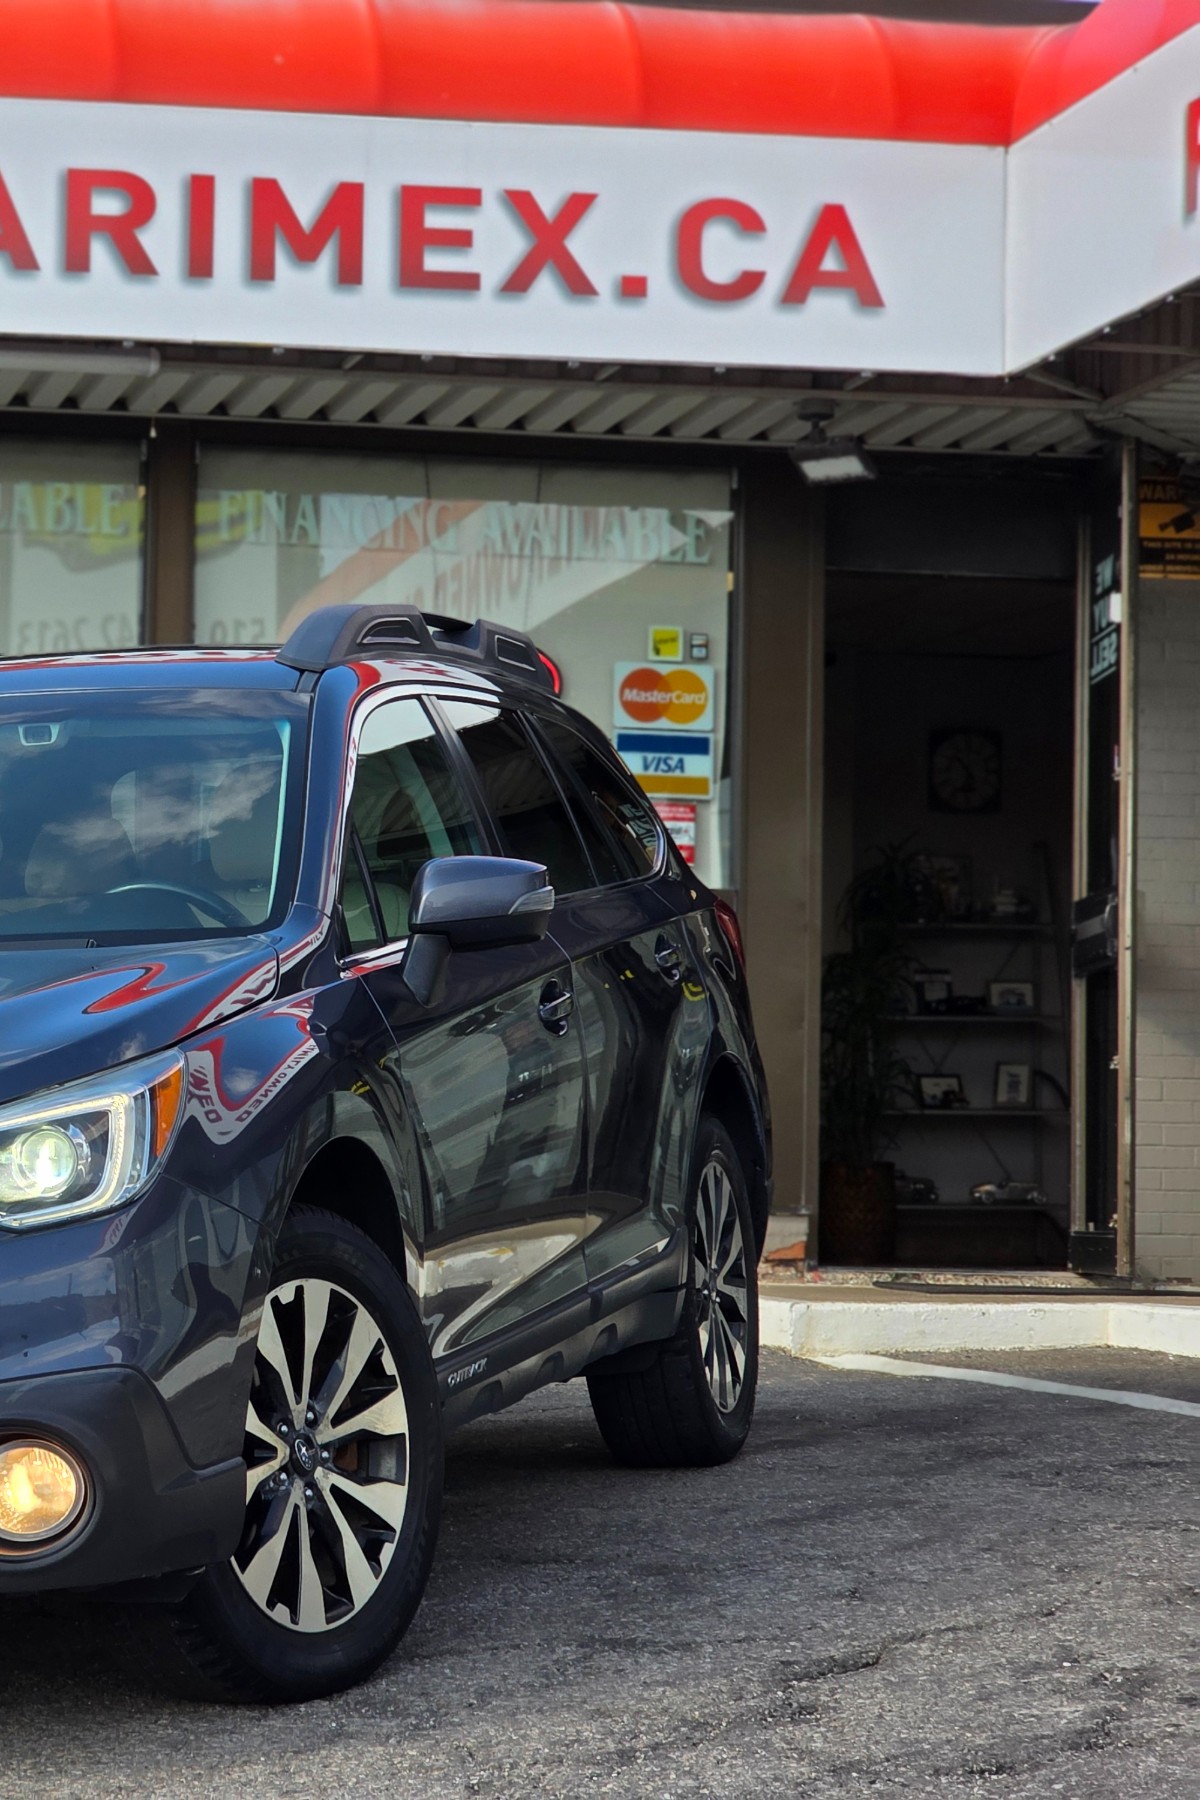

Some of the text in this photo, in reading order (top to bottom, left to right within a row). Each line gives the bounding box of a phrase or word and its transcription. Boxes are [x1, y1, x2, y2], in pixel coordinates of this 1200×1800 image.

[480, 499, 713, 565] AVAILABLE
[622, 688, 706, 705] MasterCard
[642, 755, 686, 774] VISA
